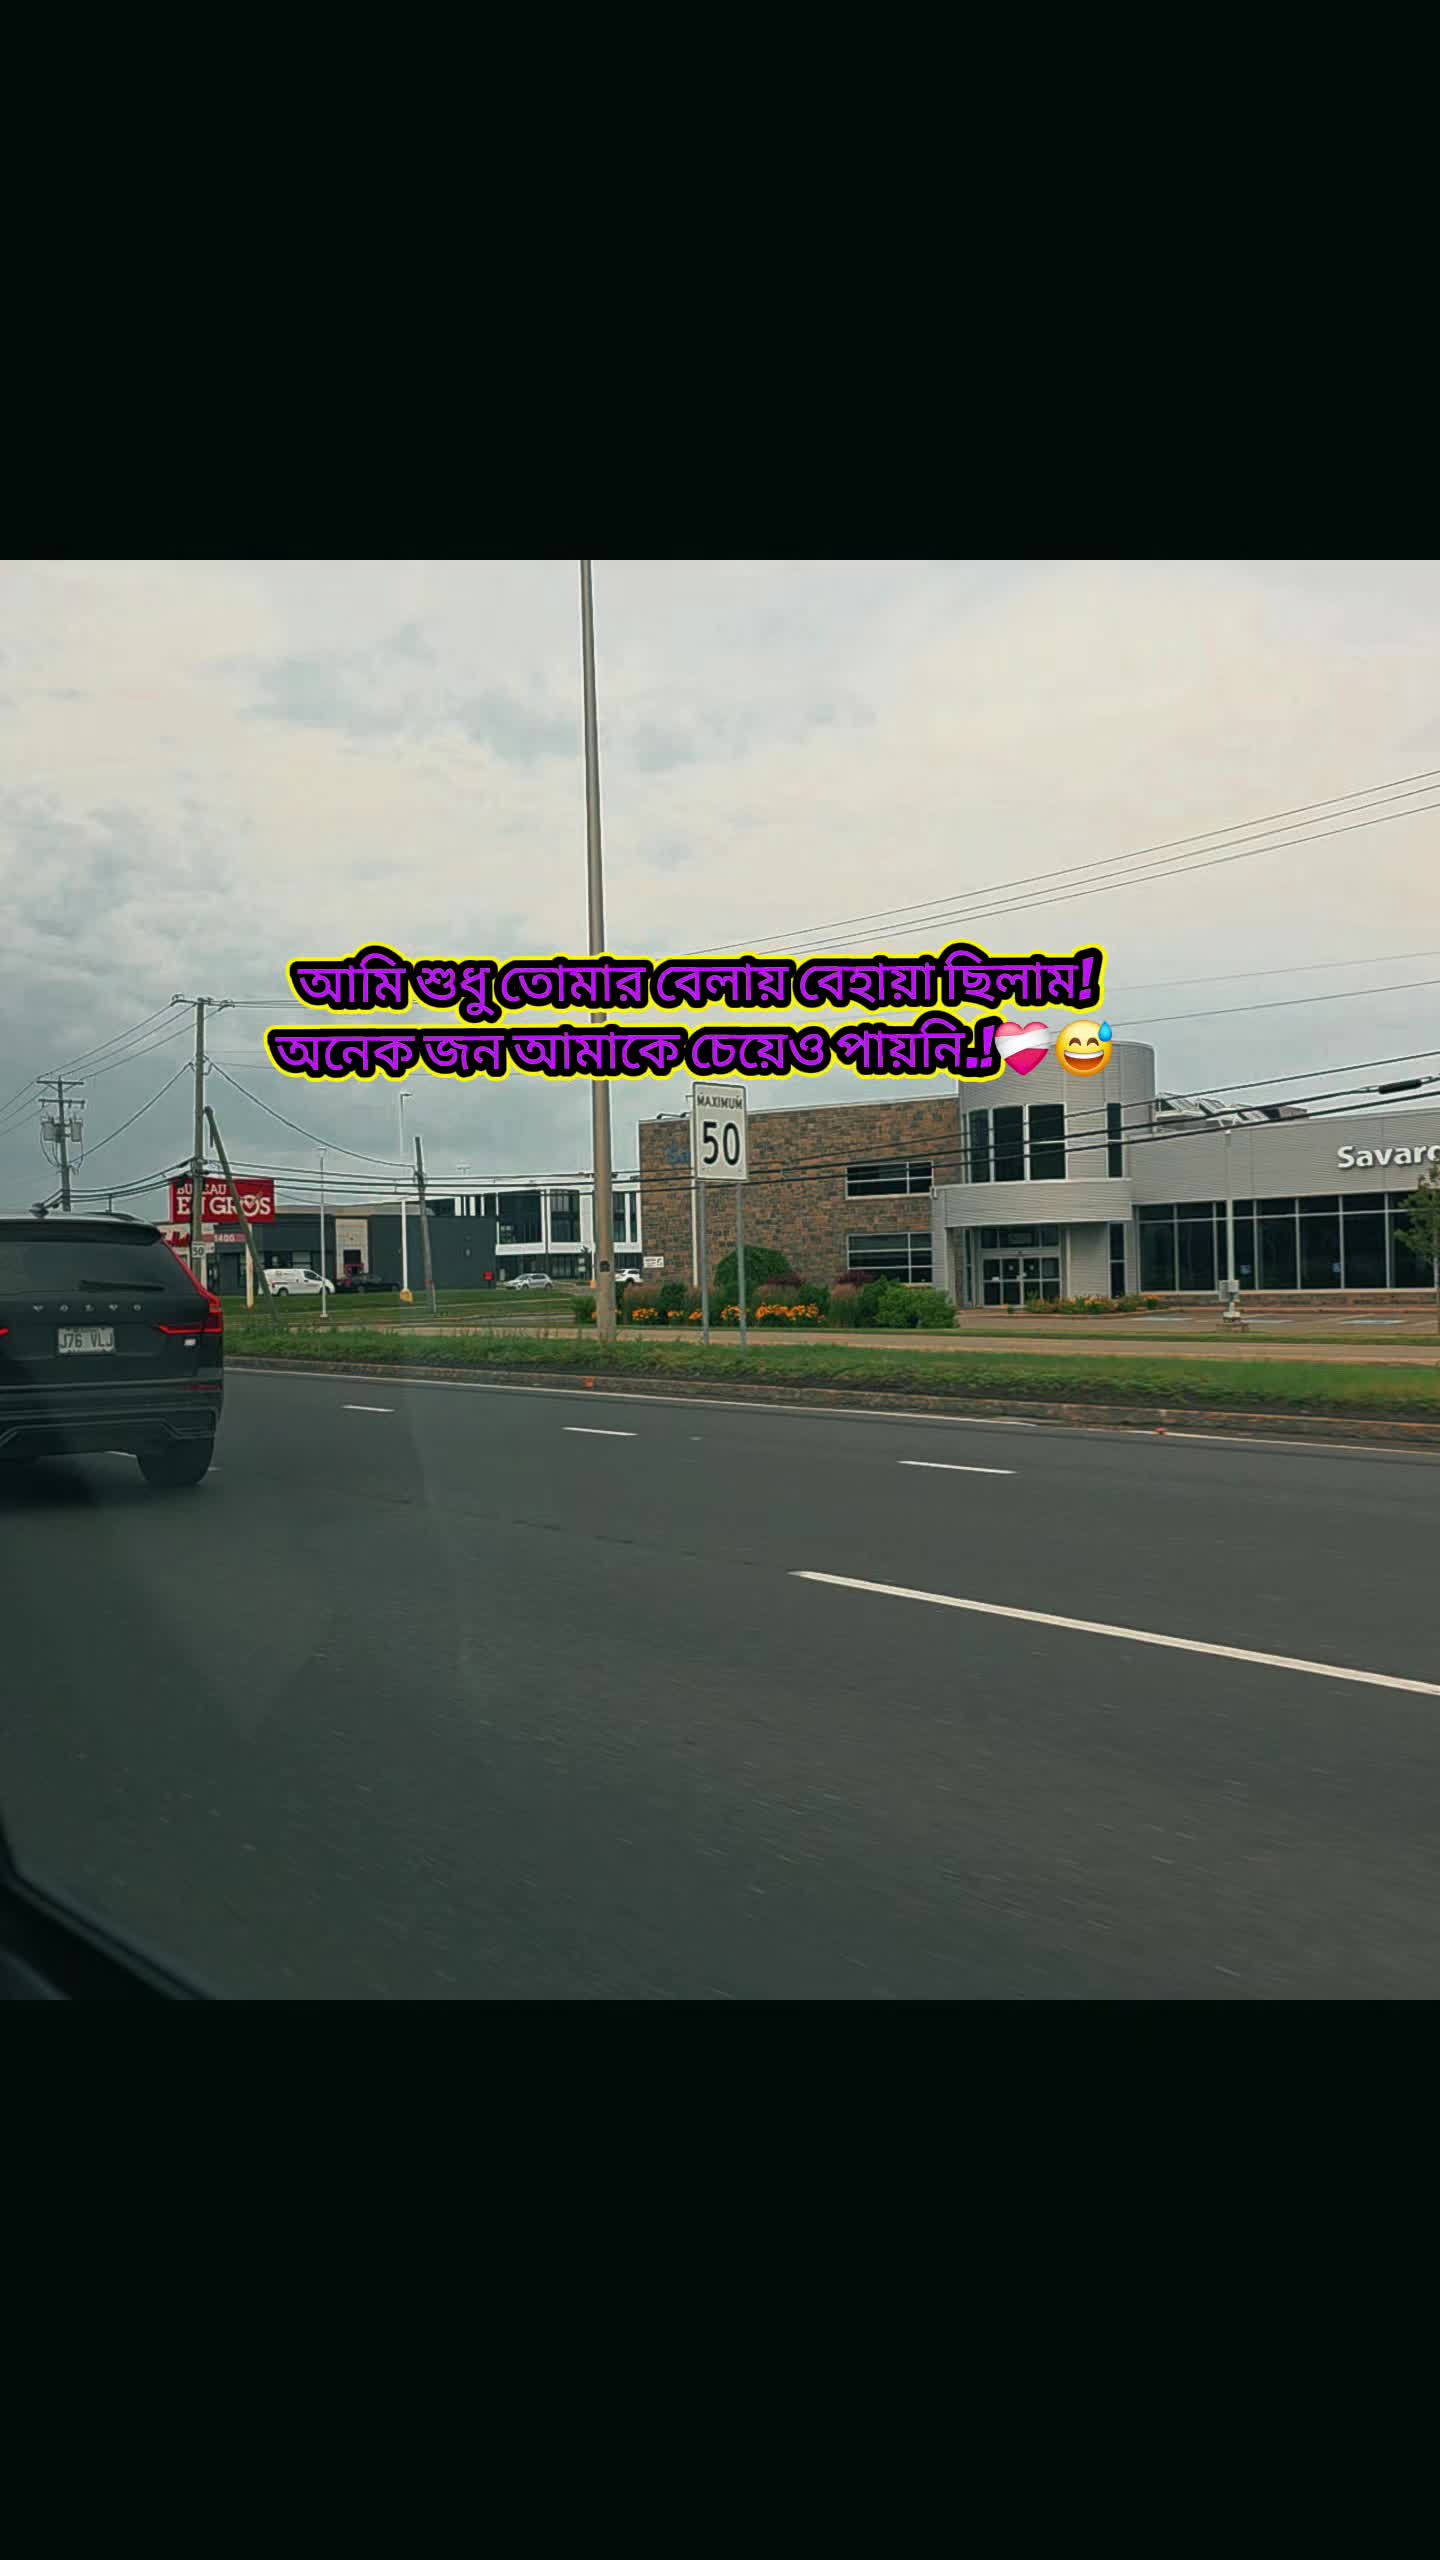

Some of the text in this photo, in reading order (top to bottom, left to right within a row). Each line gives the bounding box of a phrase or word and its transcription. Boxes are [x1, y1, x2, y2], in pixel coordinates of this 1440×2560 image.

[697, 1095, 742, 1109] MAXIMUM
[703, 1121, 740, 1165] 50
[176, 1183, 227, 1195] BUEAU
[32, 1304, 142, 1312] VOLVO
